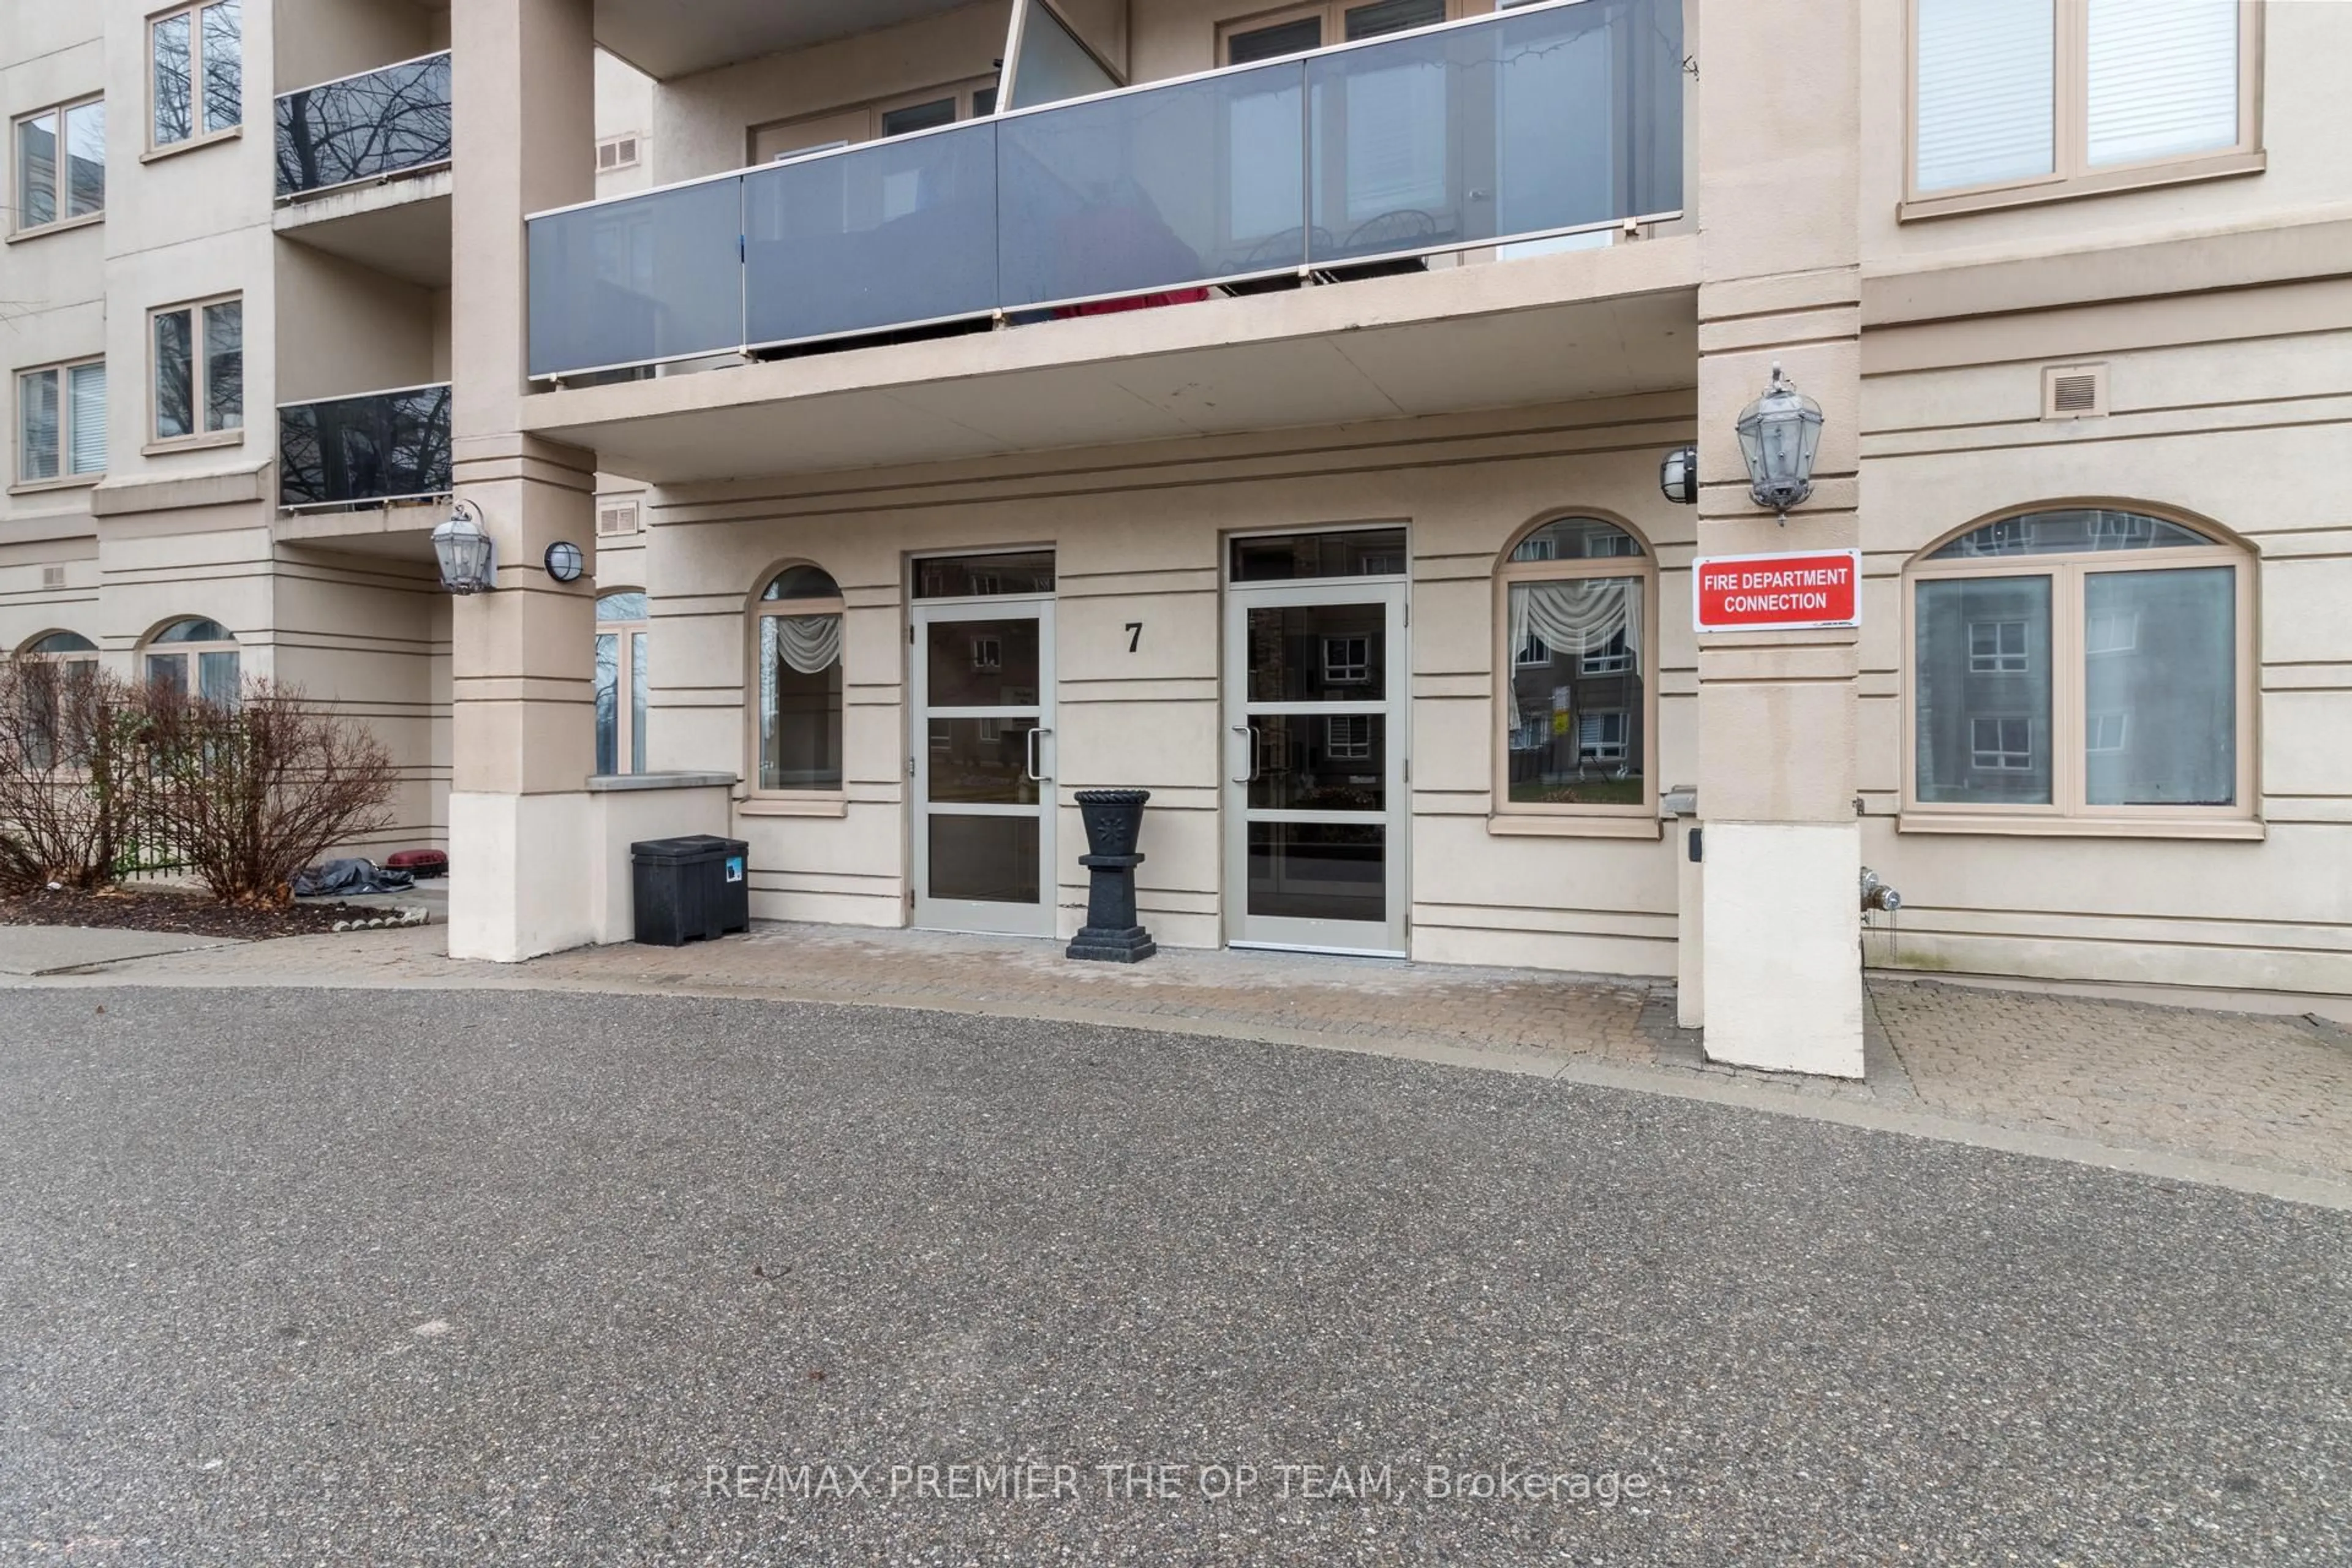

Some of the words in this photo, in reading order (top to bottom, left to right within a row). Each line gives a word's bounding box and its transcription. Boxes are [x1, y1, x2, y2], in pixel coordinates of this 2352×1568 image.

[1705, 574, 1738, 591] FIRE
[1743, 568, 1848, 589] DEPARTMENT
[1724, 593, 1826, 612] CONNECTION
[1125, 622, 1142, 652] 7
